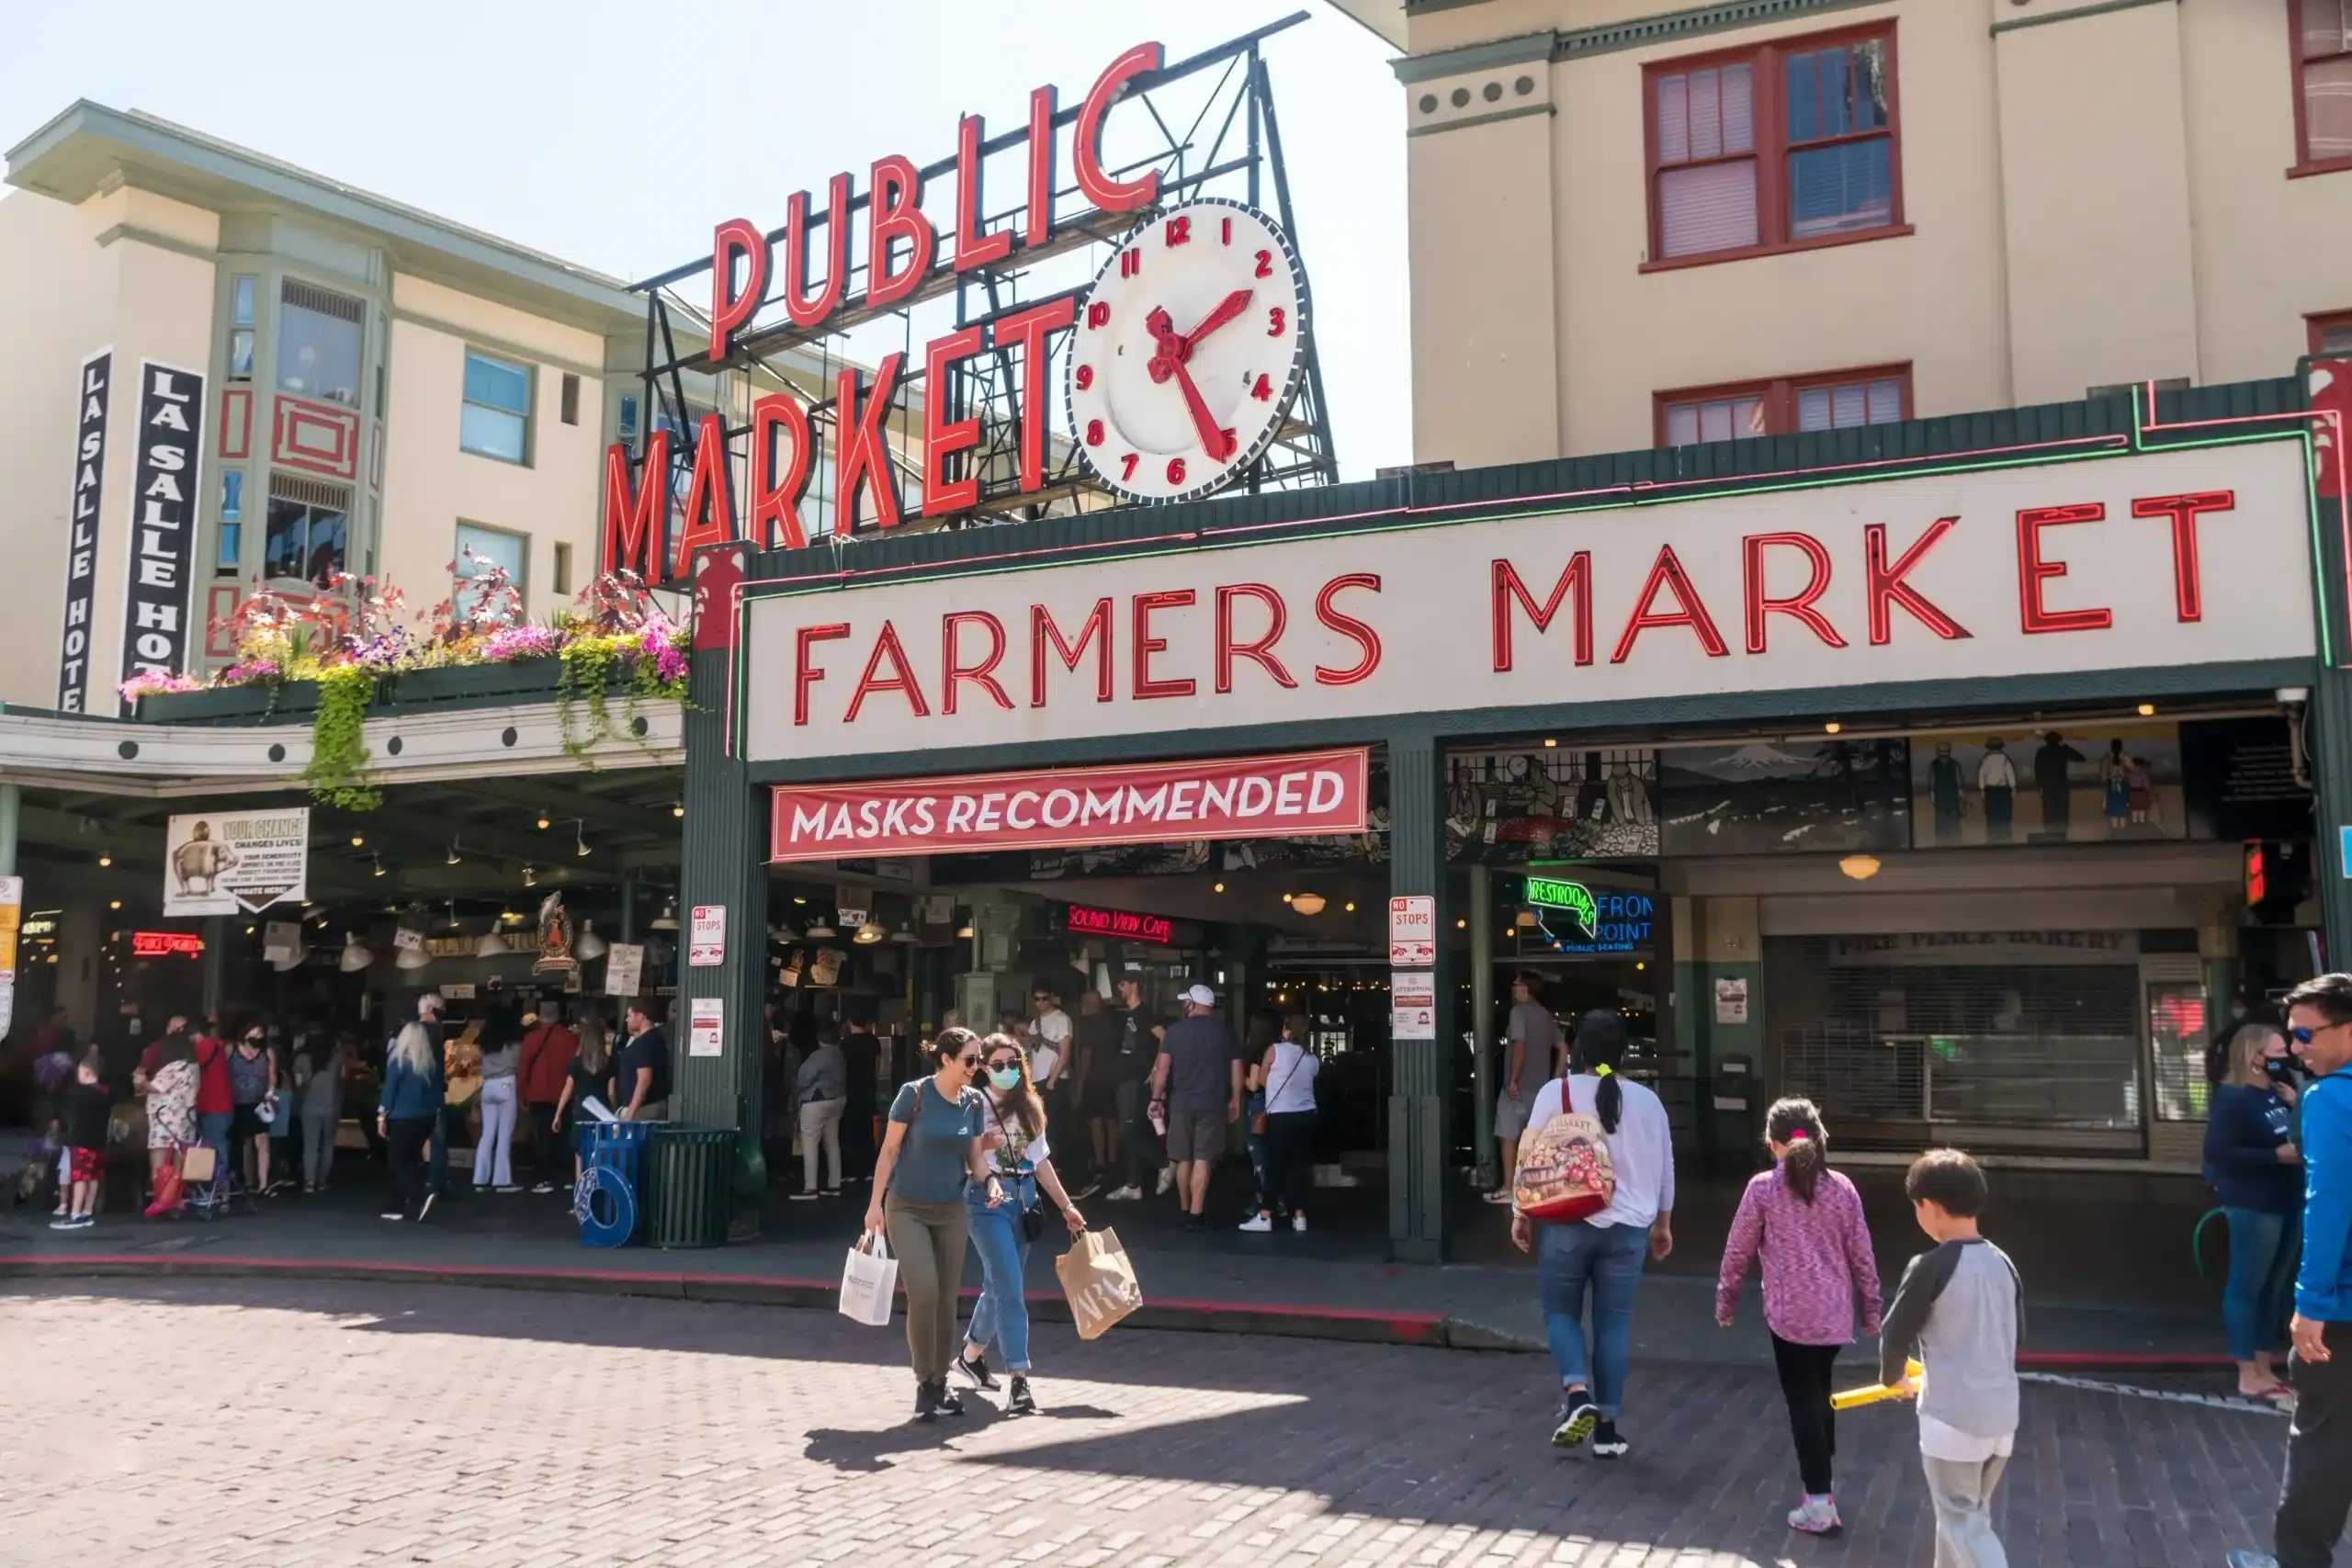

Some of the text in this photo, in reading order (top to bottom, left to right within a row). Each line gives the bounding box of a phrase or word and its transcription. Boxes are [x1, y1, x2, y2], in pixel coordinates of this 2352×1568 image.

[709, 40, 1166, 363] PUBLIC
[1165, 216, 1191, 247] 12
[1222, 217, 1231, 246] 1
[1121, 247, 1140, 278] 11
[1254, 249, 1273, 279] 2
[1088, 300, 1110, 331] 10
[1267, 307, 1285, 338] 3
[1076, 364, 1093, 390] 9
[1250, 373, 1273, 401] 4
[84, 368, 105, 424] LA
[150, 371, 190, 433] LA
[602, 296, 1078, 587] MARKET
[1086, 419, 1105, 447] 8
[1121, 453, 1139, 482] 7
[1167, 457, 1186, 485] 6
[72, 431, 100, 581] SALLE
[138, 445, 185, 589] SALLE
[794, 490, 2234, 727] FARMERS MARKET
[790, 771, 1344, 843] MASKS RECOMMENDED
[221, 818, 304, 840] YOUR CHANGE
[234, 840, 274, 849] CHANGES
[695, 908, 706, 919] NO
[1069, 905, 1110, 928] SOUND
[1393, 899, 1406, 910] NO
[1532, 881, 1594, 925] RESTROOMS
[696, 919, 721, 931] STOPS
[1396, 913, 1429, 926] STOPS
